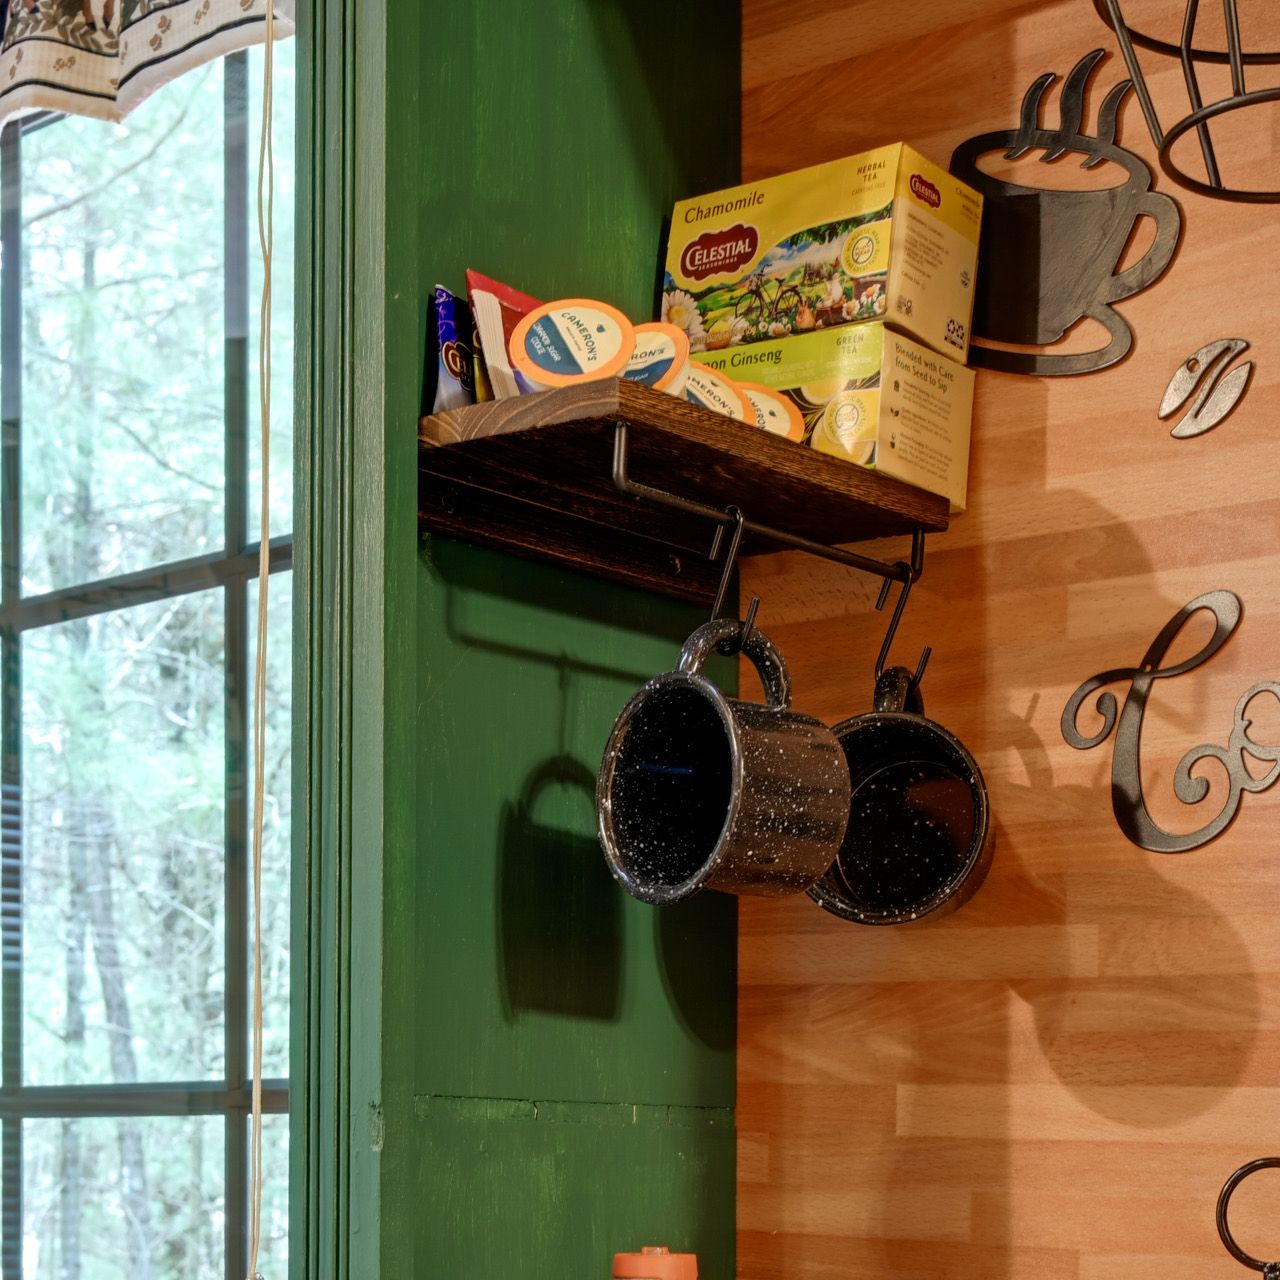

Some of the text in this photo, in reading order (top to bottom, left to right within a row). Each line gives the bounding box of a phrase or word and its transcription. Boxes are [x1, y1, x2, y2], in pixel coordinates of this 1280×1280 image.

[856, 159, 887, 176] HERBAL
[863, 171, 878, 183] TEA
[911, 176, 939, 203] CELESTIAL
[684, 190, 765, 224] Chamomile
[685, 238, 752, 271] CELESTIAL
[698, 256, 739, 271] SEASONINGS
[561, 312, 597, 362] CAMERON'S
[836, 333, 864, 346] GREEN
[631, 347, 666, 361] RON'S
[731, 350, 783, 368] Ginseng
[842, 346, 858, 355] TEA
[895, 342, 954, 382] Blended with Care
[895, 357, 948, 394] from Seed to Sip
